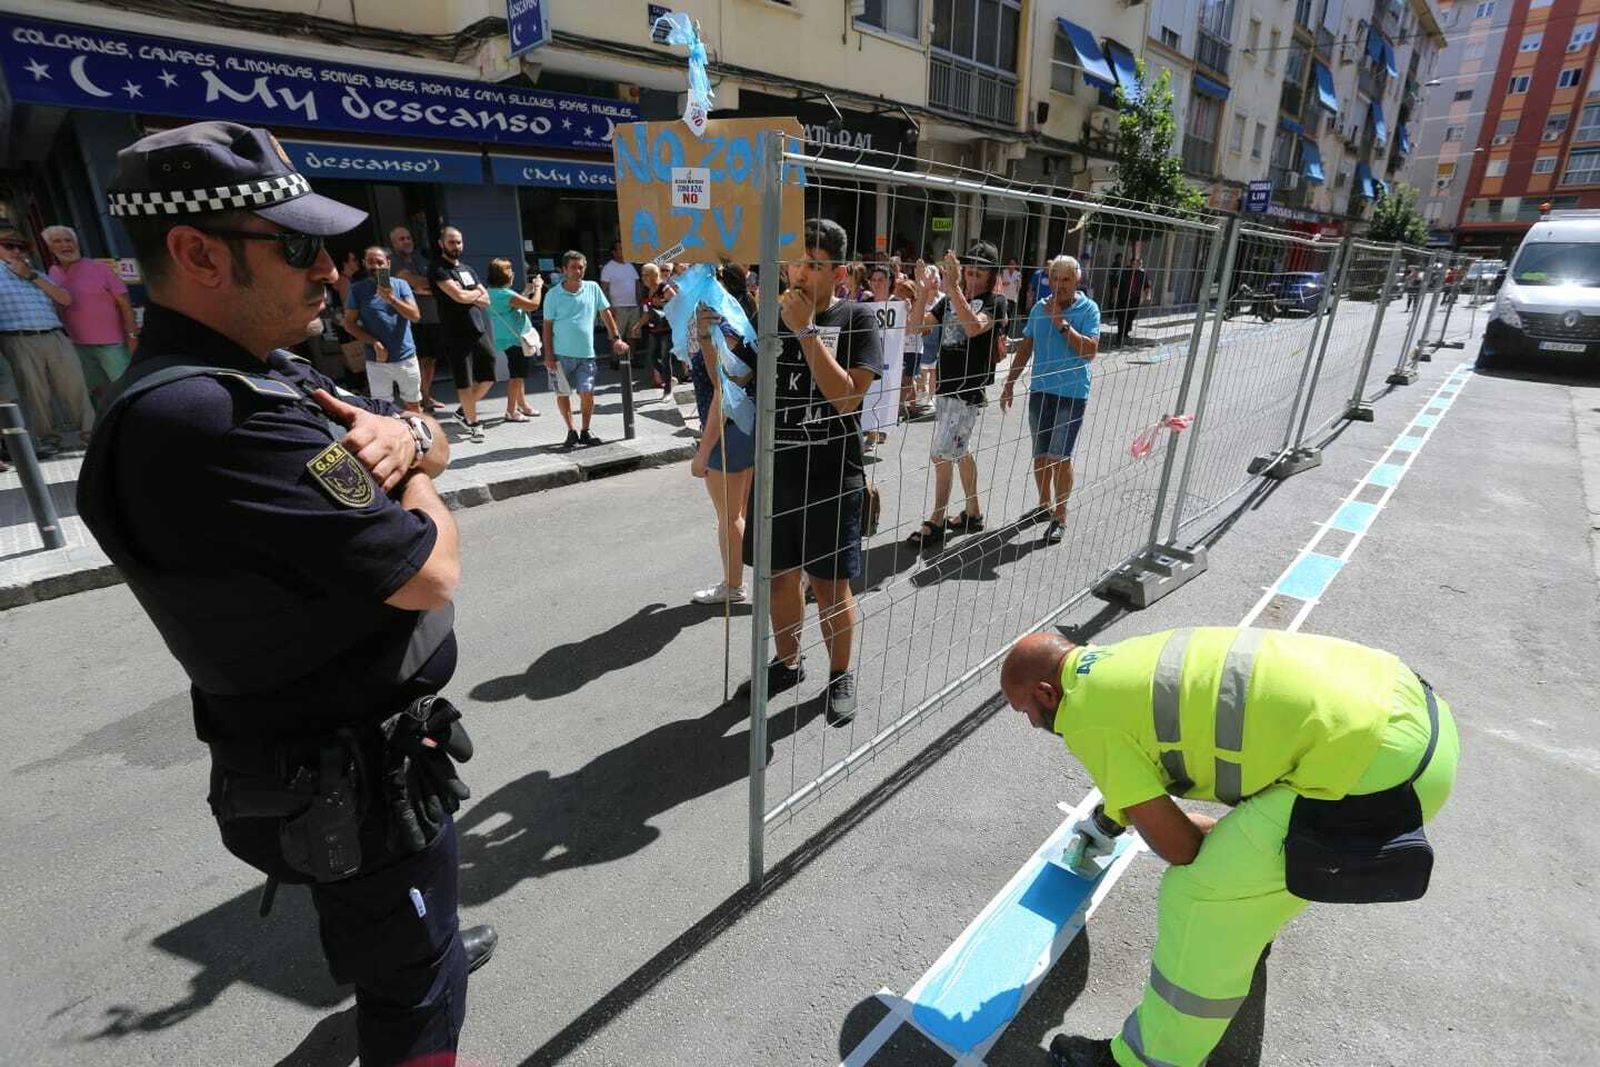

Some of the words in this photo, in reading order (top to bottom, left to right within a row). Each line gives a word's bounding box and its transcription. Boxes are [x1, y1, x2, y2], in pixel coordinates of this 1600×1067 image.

[12, 27, 133, 59] COLCHONES,
[225, 57, 316, 81] ALMOHADAS,
[375, 76, 418, 94] BASES,
[421, 82, 451, 96] ROPA
[454, 87, 470, 99] DE
[201, 69, 318, 121] My
[342, 86, 551, 134] descanso
[614, 122, 686, 184] NO
[682, 193, 698, 204] NO
